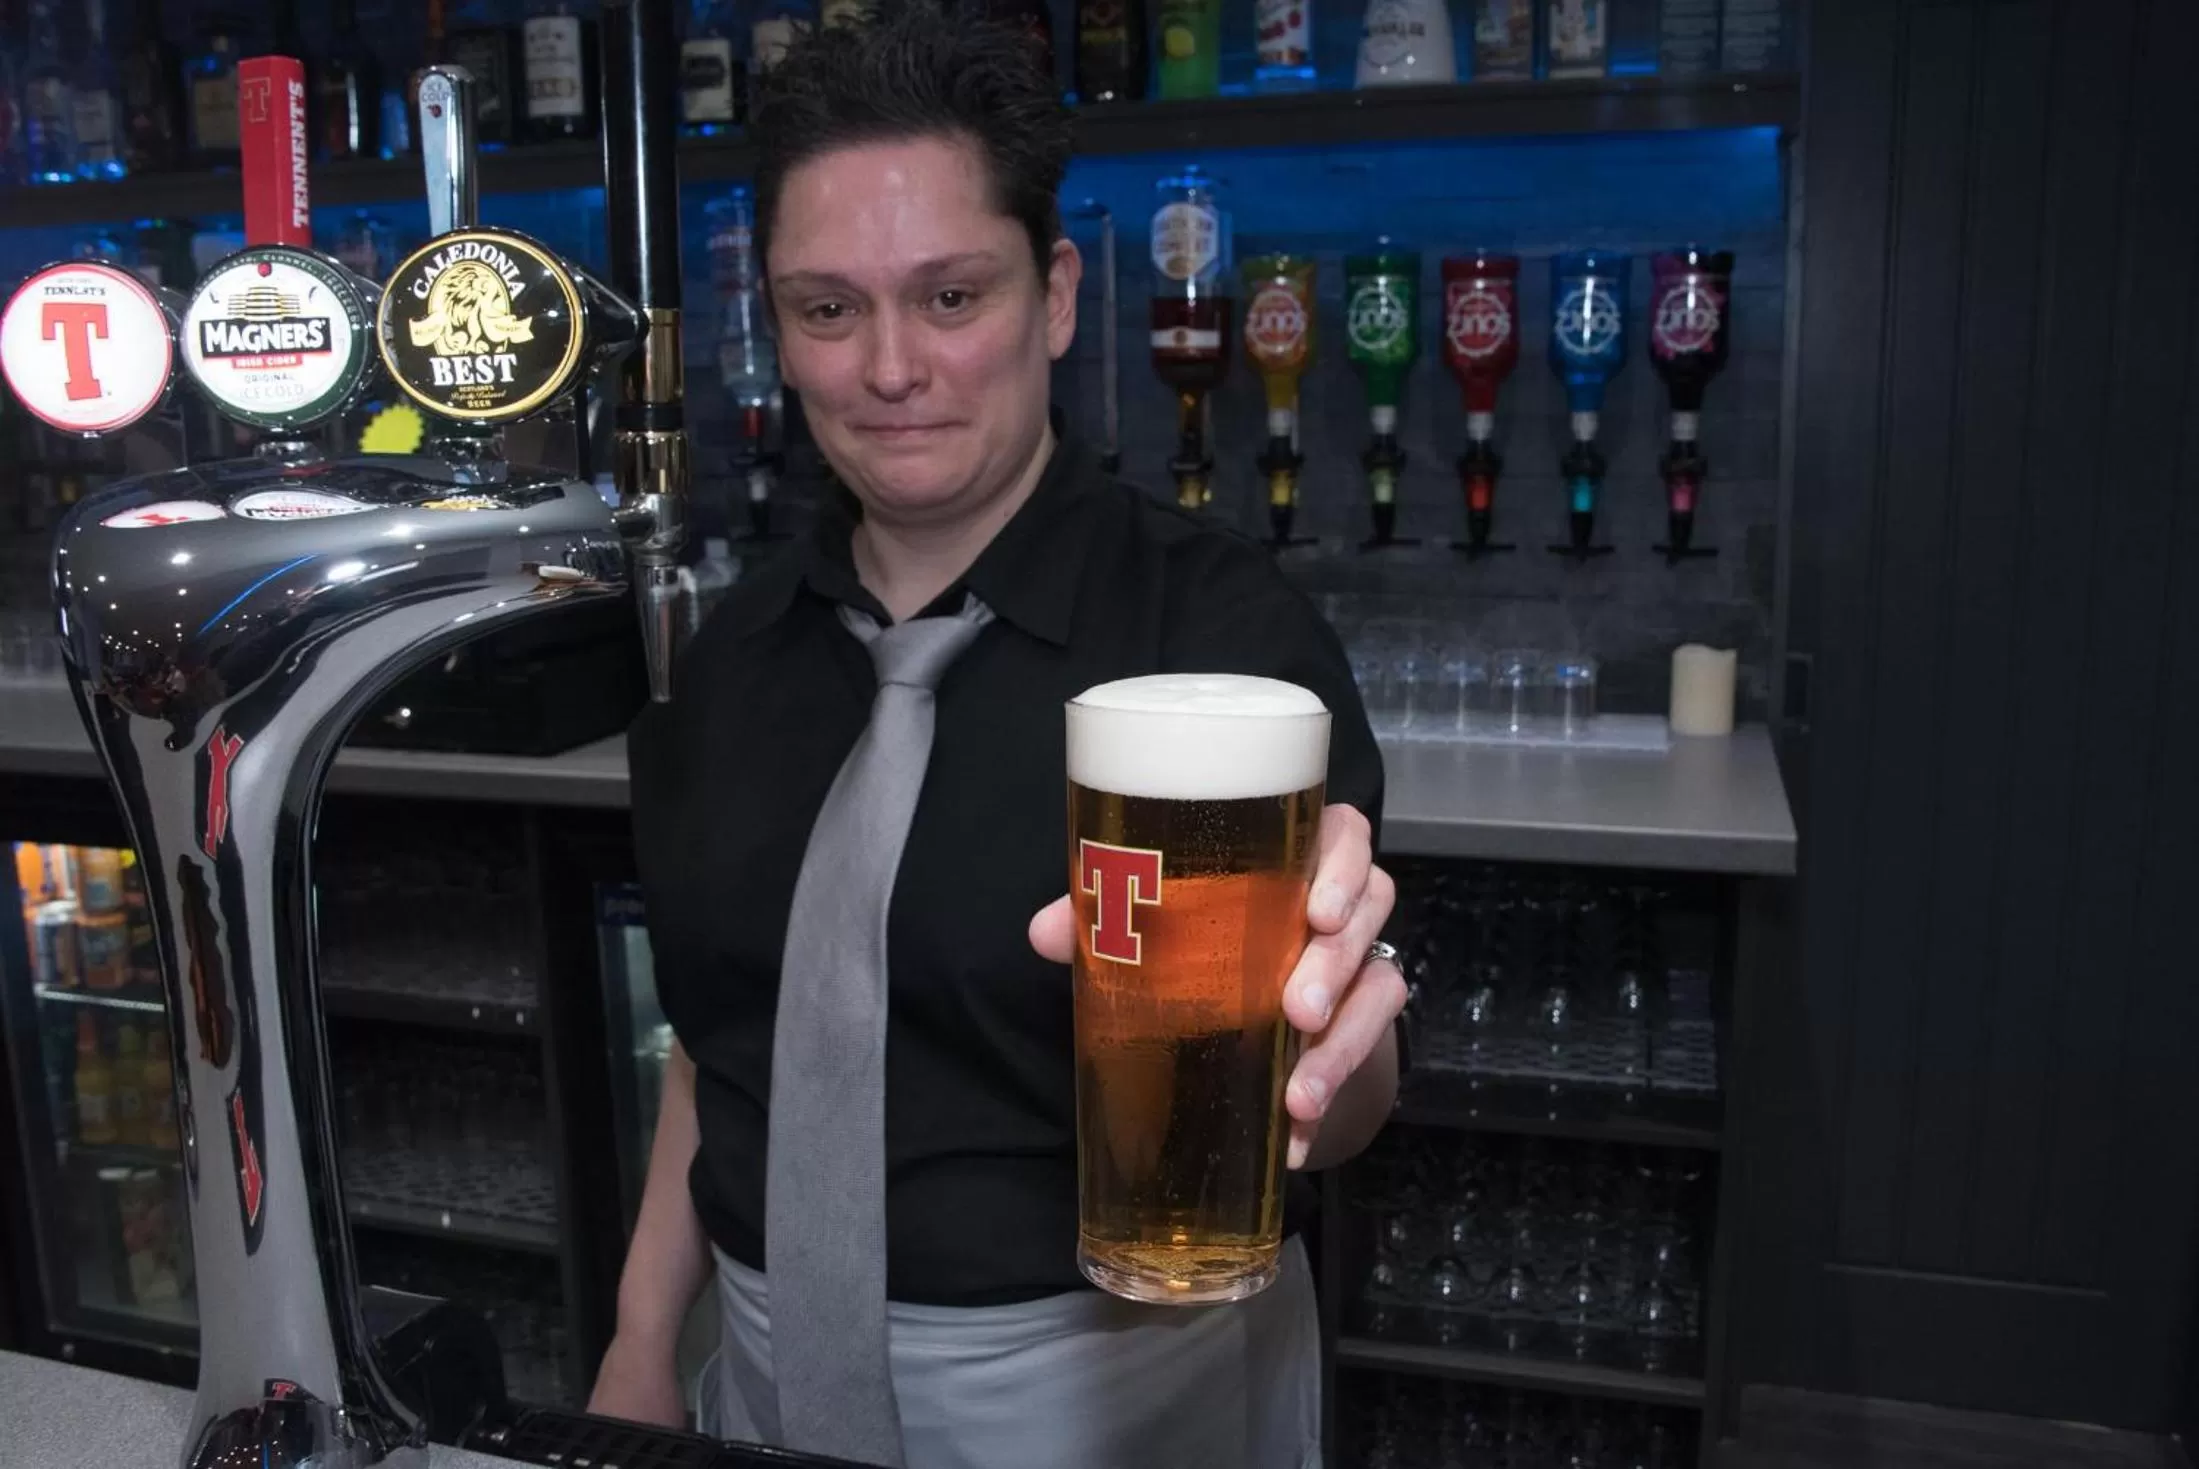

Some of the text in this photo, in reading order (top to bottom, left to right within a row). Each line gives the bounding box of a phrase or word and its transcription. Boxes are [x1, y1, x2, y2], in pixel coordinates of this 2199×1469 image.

[243, 77, 272, 123] T
[288, 77, 310, 229] TENNENT'S
[413, 241, 527, 301] CALEDONIA
[42, 302, 109, 402] T
[204, 319, 325, 353] MAGNERS
[266, 354, 297, 366] CIDER
[429, 353, 517, 387] BEST
[1080, 837, 1163, 967] T
